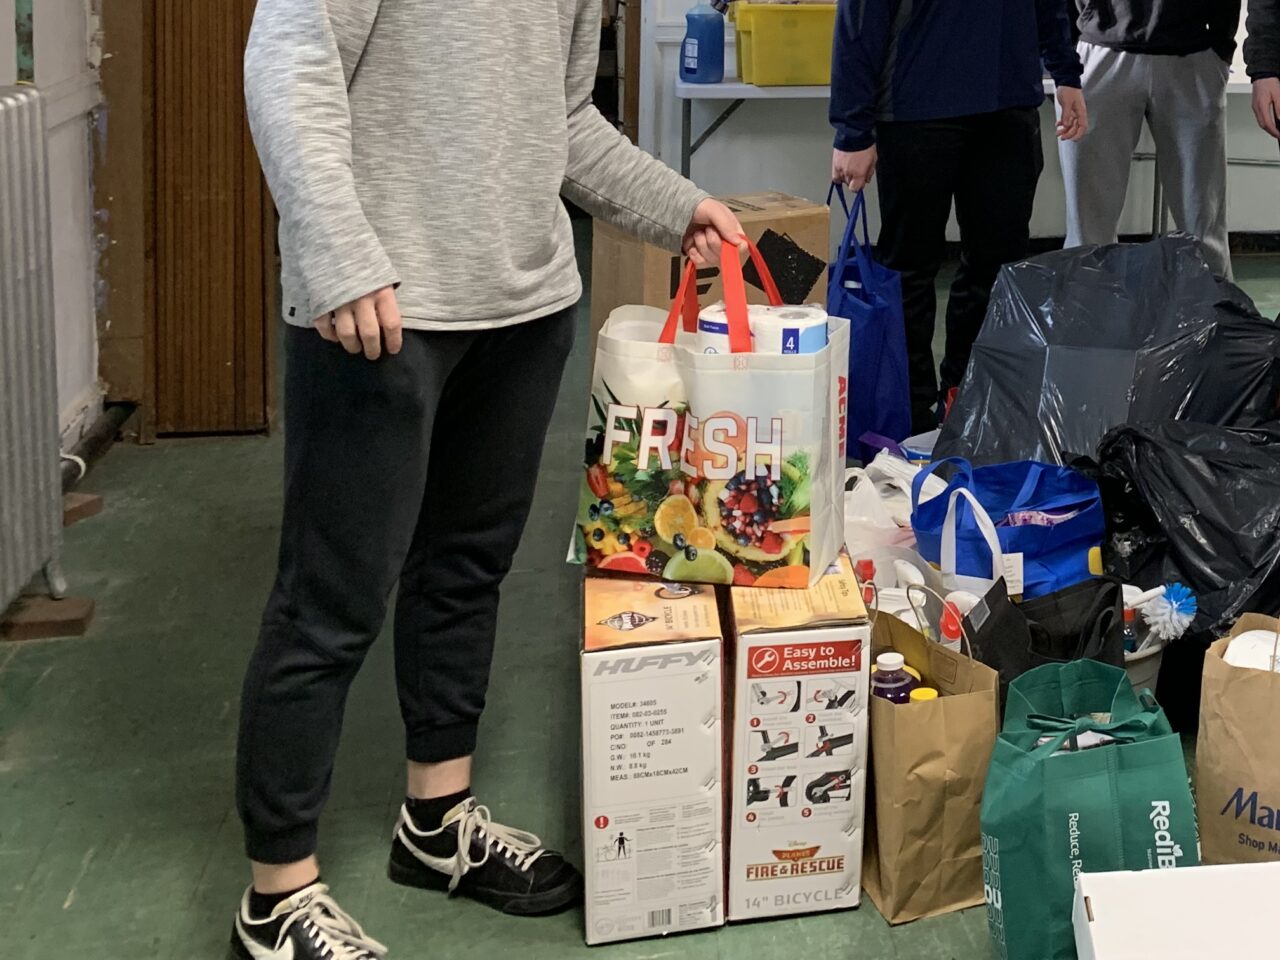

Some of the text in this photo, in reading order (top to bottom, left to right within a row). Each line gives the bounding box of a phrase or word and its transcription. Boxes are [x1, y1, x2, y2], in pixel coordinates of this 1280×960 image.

[786, 337, 794, 350] 4
[838, 376, 847, 458] ACME
[602, 403, 783, 481] FRESH
[783, 646, 835, 659] Easy to
[593, 649, 713, 677] HUFFY
[782, 655, 856, 671] Assemble!
[1069, 812, 1081, 859] Reduce,
[1238, 833, 1265, 852] Shop
[773, 888, 843, 907] BICYCLE
